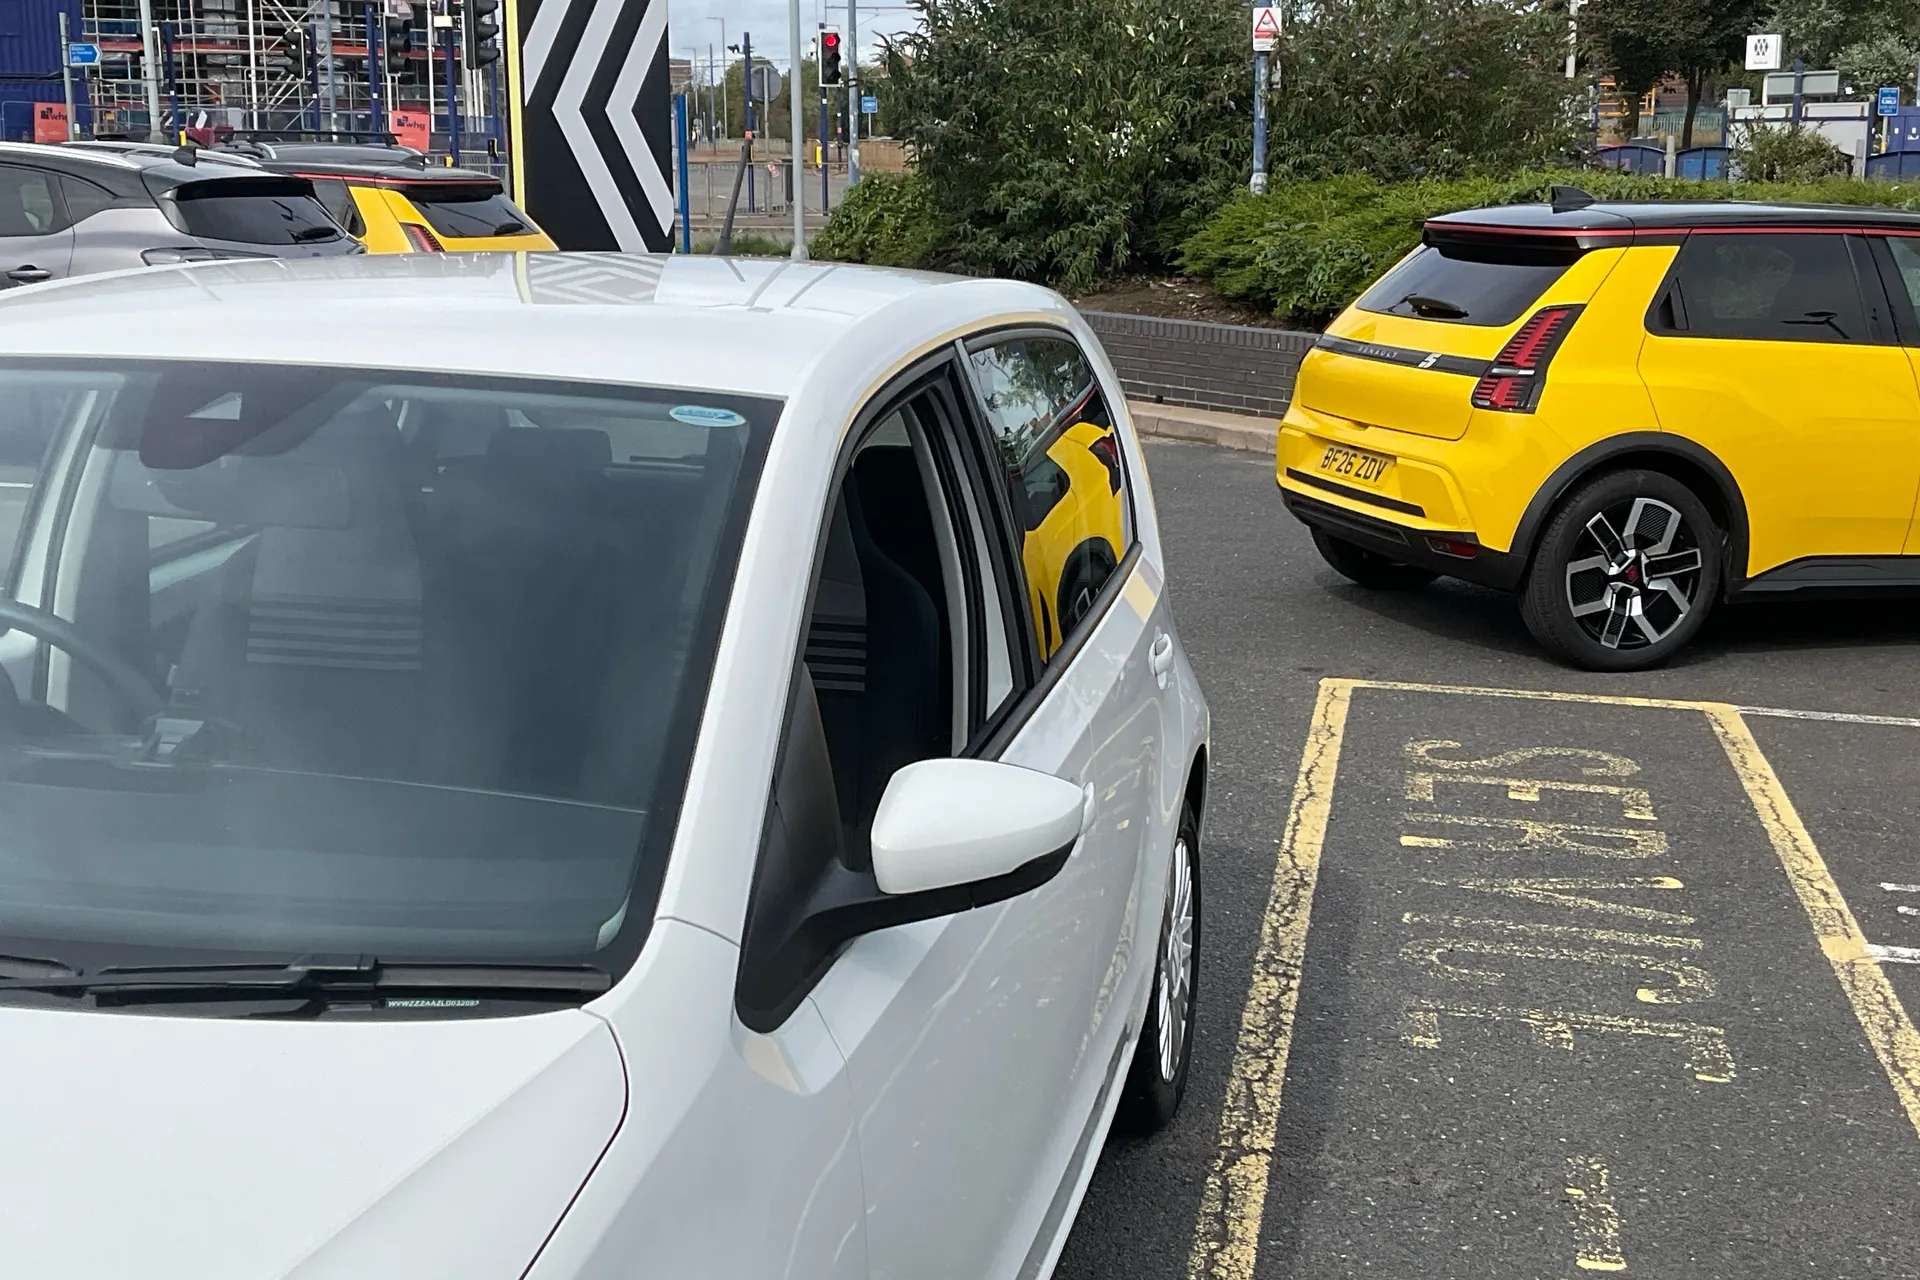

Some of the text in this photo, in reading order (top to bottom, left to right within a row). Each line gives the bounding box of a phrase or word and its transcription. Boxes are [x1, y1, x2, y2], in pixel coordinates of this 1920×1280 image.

[406, 121, 425, 131] whg
[1358, 345, 1442, 368] RENAULT 5
[1321, 447, 1357, 474] BF26
[1400, 739, 1737, 1083] SERVICE
